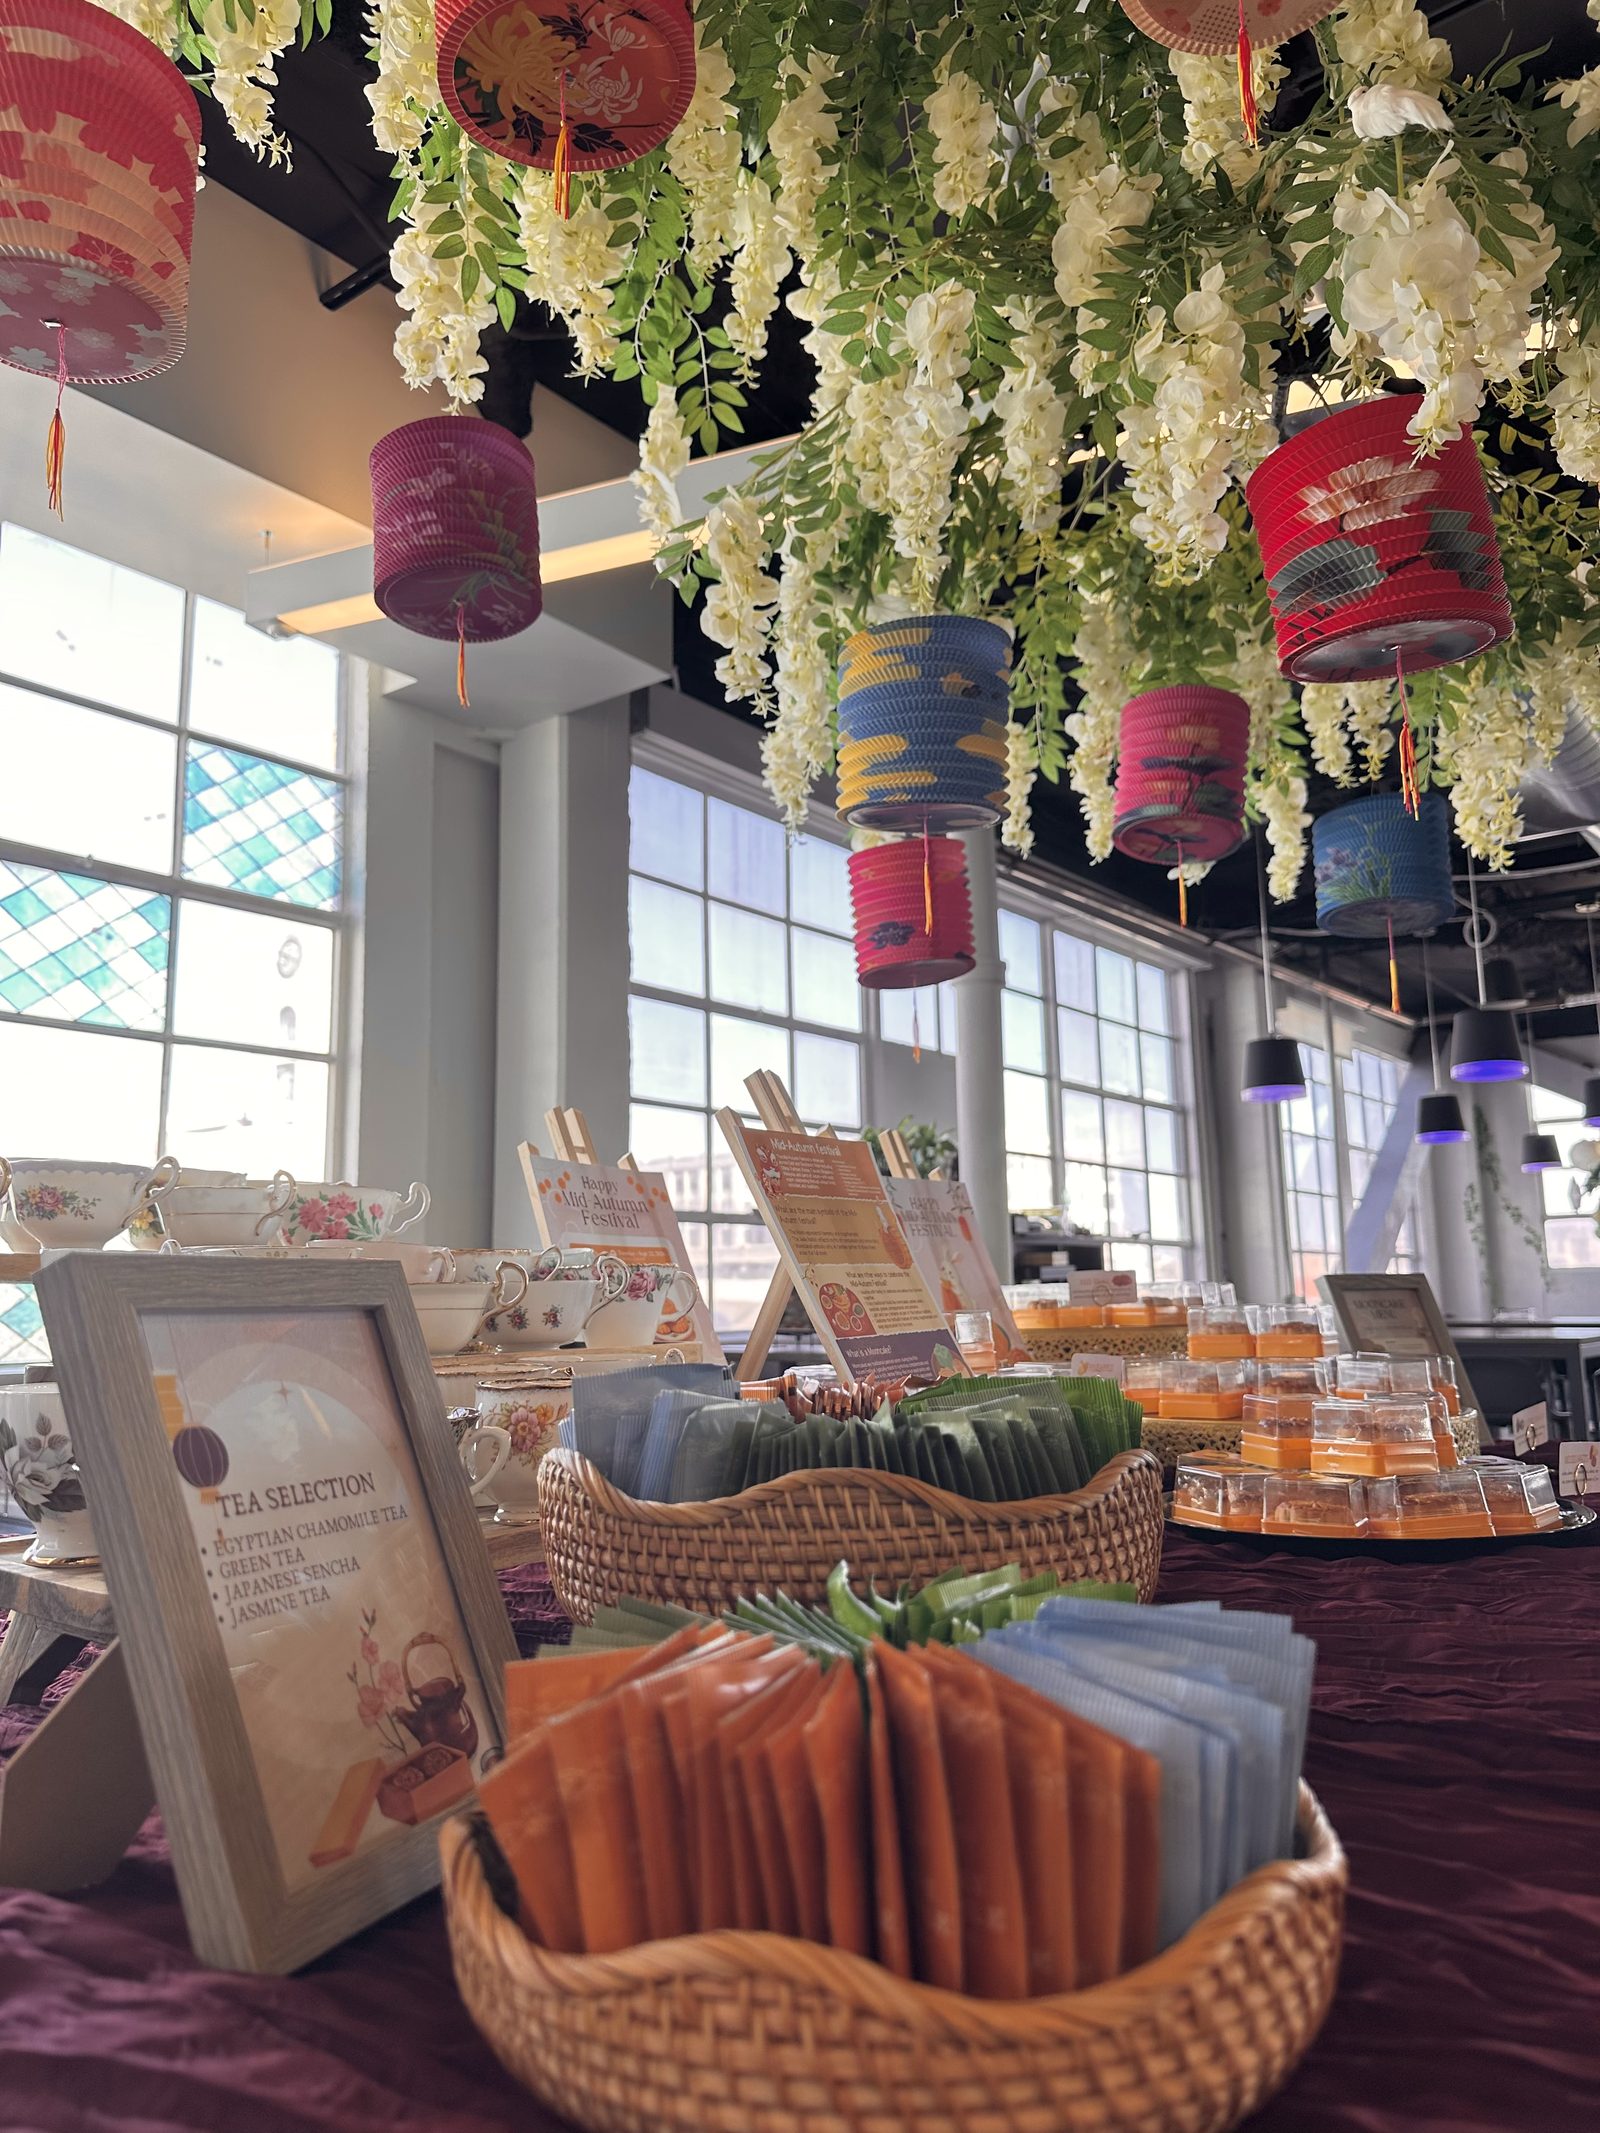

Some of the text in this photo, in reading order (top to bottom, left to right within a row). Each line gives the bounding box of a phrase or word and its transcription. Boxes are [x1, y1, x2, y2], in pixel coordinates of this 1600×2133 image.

[770, 1138, 816, 1154] Mid-Autumn
[581, 1176, 618, 1195] Happy
[909, 1196, 940, 1210] HAPPY
[581, 1210, 640, 1229] Festival
[909, 1223, 957, 1237] FESTIVAL
[215, 1472, 376, 1518] TEA SELECTION
[213, 1504, 408, 1557] EGYPTIAN CHAMOMILE TEA
[219, 1547, 305, 1579] GREEN TEA
[224, 1556, 361, 1606] JAPANESE SENCHA
[230, 1585, 331, 1629] JASMINE TEA
